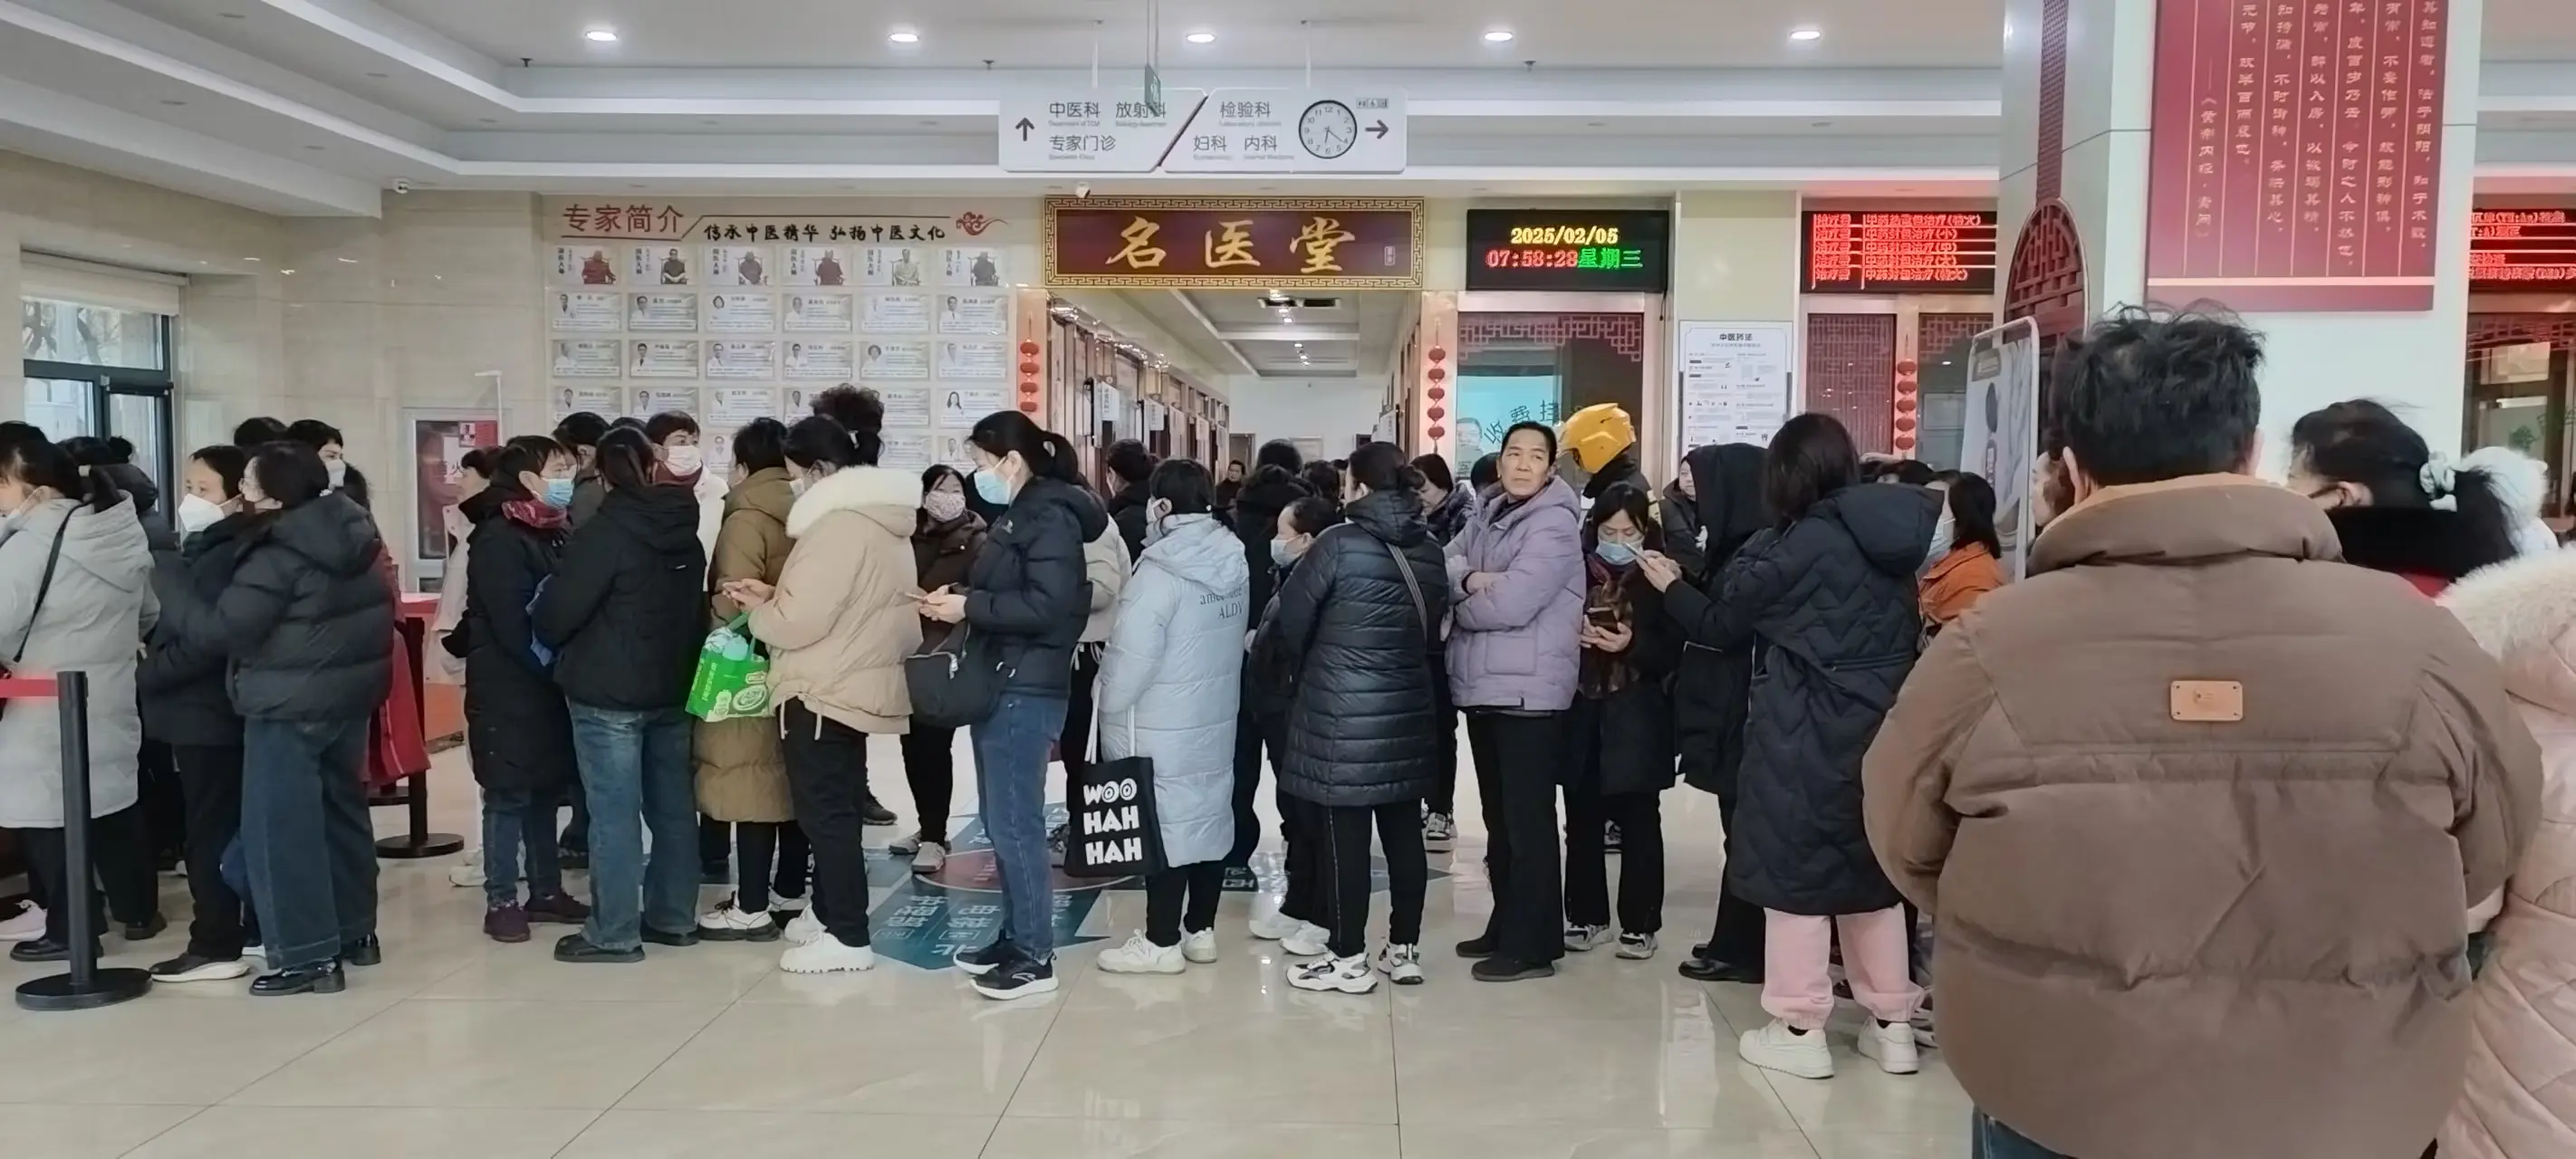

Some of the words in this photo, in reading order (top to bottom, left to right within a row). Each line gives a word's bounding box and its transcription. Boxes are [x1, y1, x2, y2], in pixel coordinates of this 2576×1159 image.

[1049, 101, 1101, 119] 中医科
[1219, 101, 1271, 119] 检验科
[1049, 134, 1117, 152] 专家门诊
[1193, 134, 1226, 152] 妇科
[1244, 134, 1277, 152] 内科
[562, 204, 684, 234] 专家简介
[704, 223, 820, 243] 传承中医精华
[829, 223, 946, 243] 弘扬中医文化
[1105, 216, 1356, 273] 名医堂
[1510, 225, 1620, 245] 2025/02/05
[1484, 399, 1582, 445] 收费挂
[1082, 778, 1138, 806] WOO
[1082, 805, 1140, 836] HAH
[1084, 837, 1143, 866] HAH
